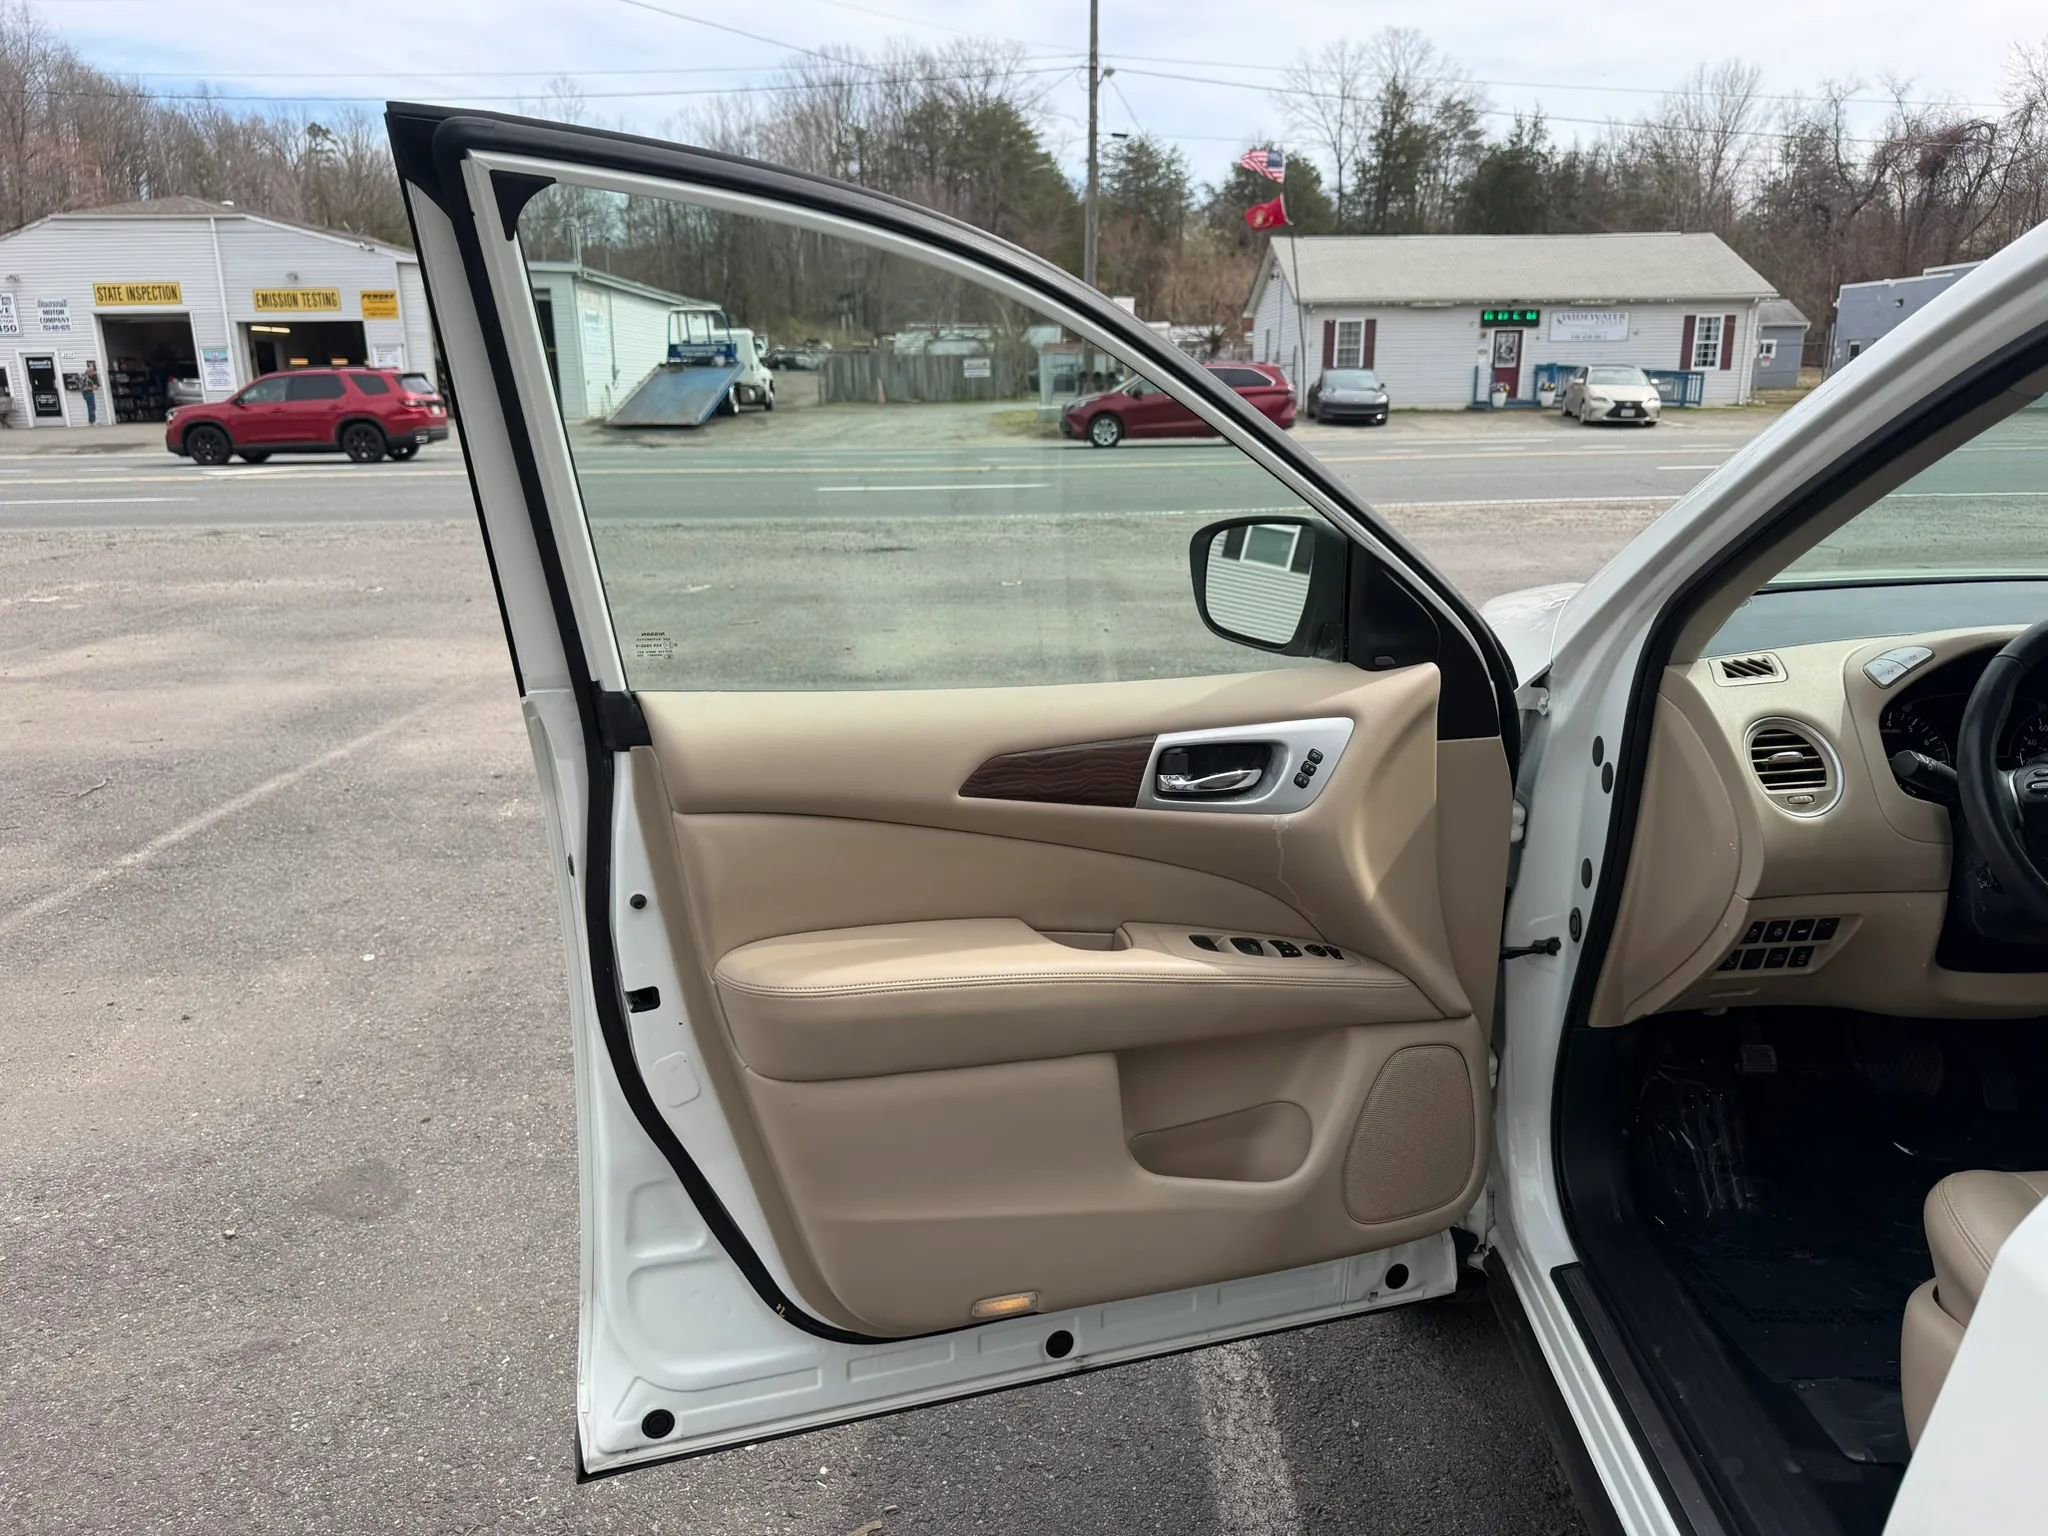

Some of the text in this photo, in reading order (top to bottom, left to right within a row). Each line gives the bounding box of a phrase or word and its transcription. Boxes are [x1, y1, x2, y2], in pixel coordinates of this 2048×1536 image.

[97, 285, 178, 301] STATE INSPECTION
[255, 291, 338, 308] EMISSION TESTING
